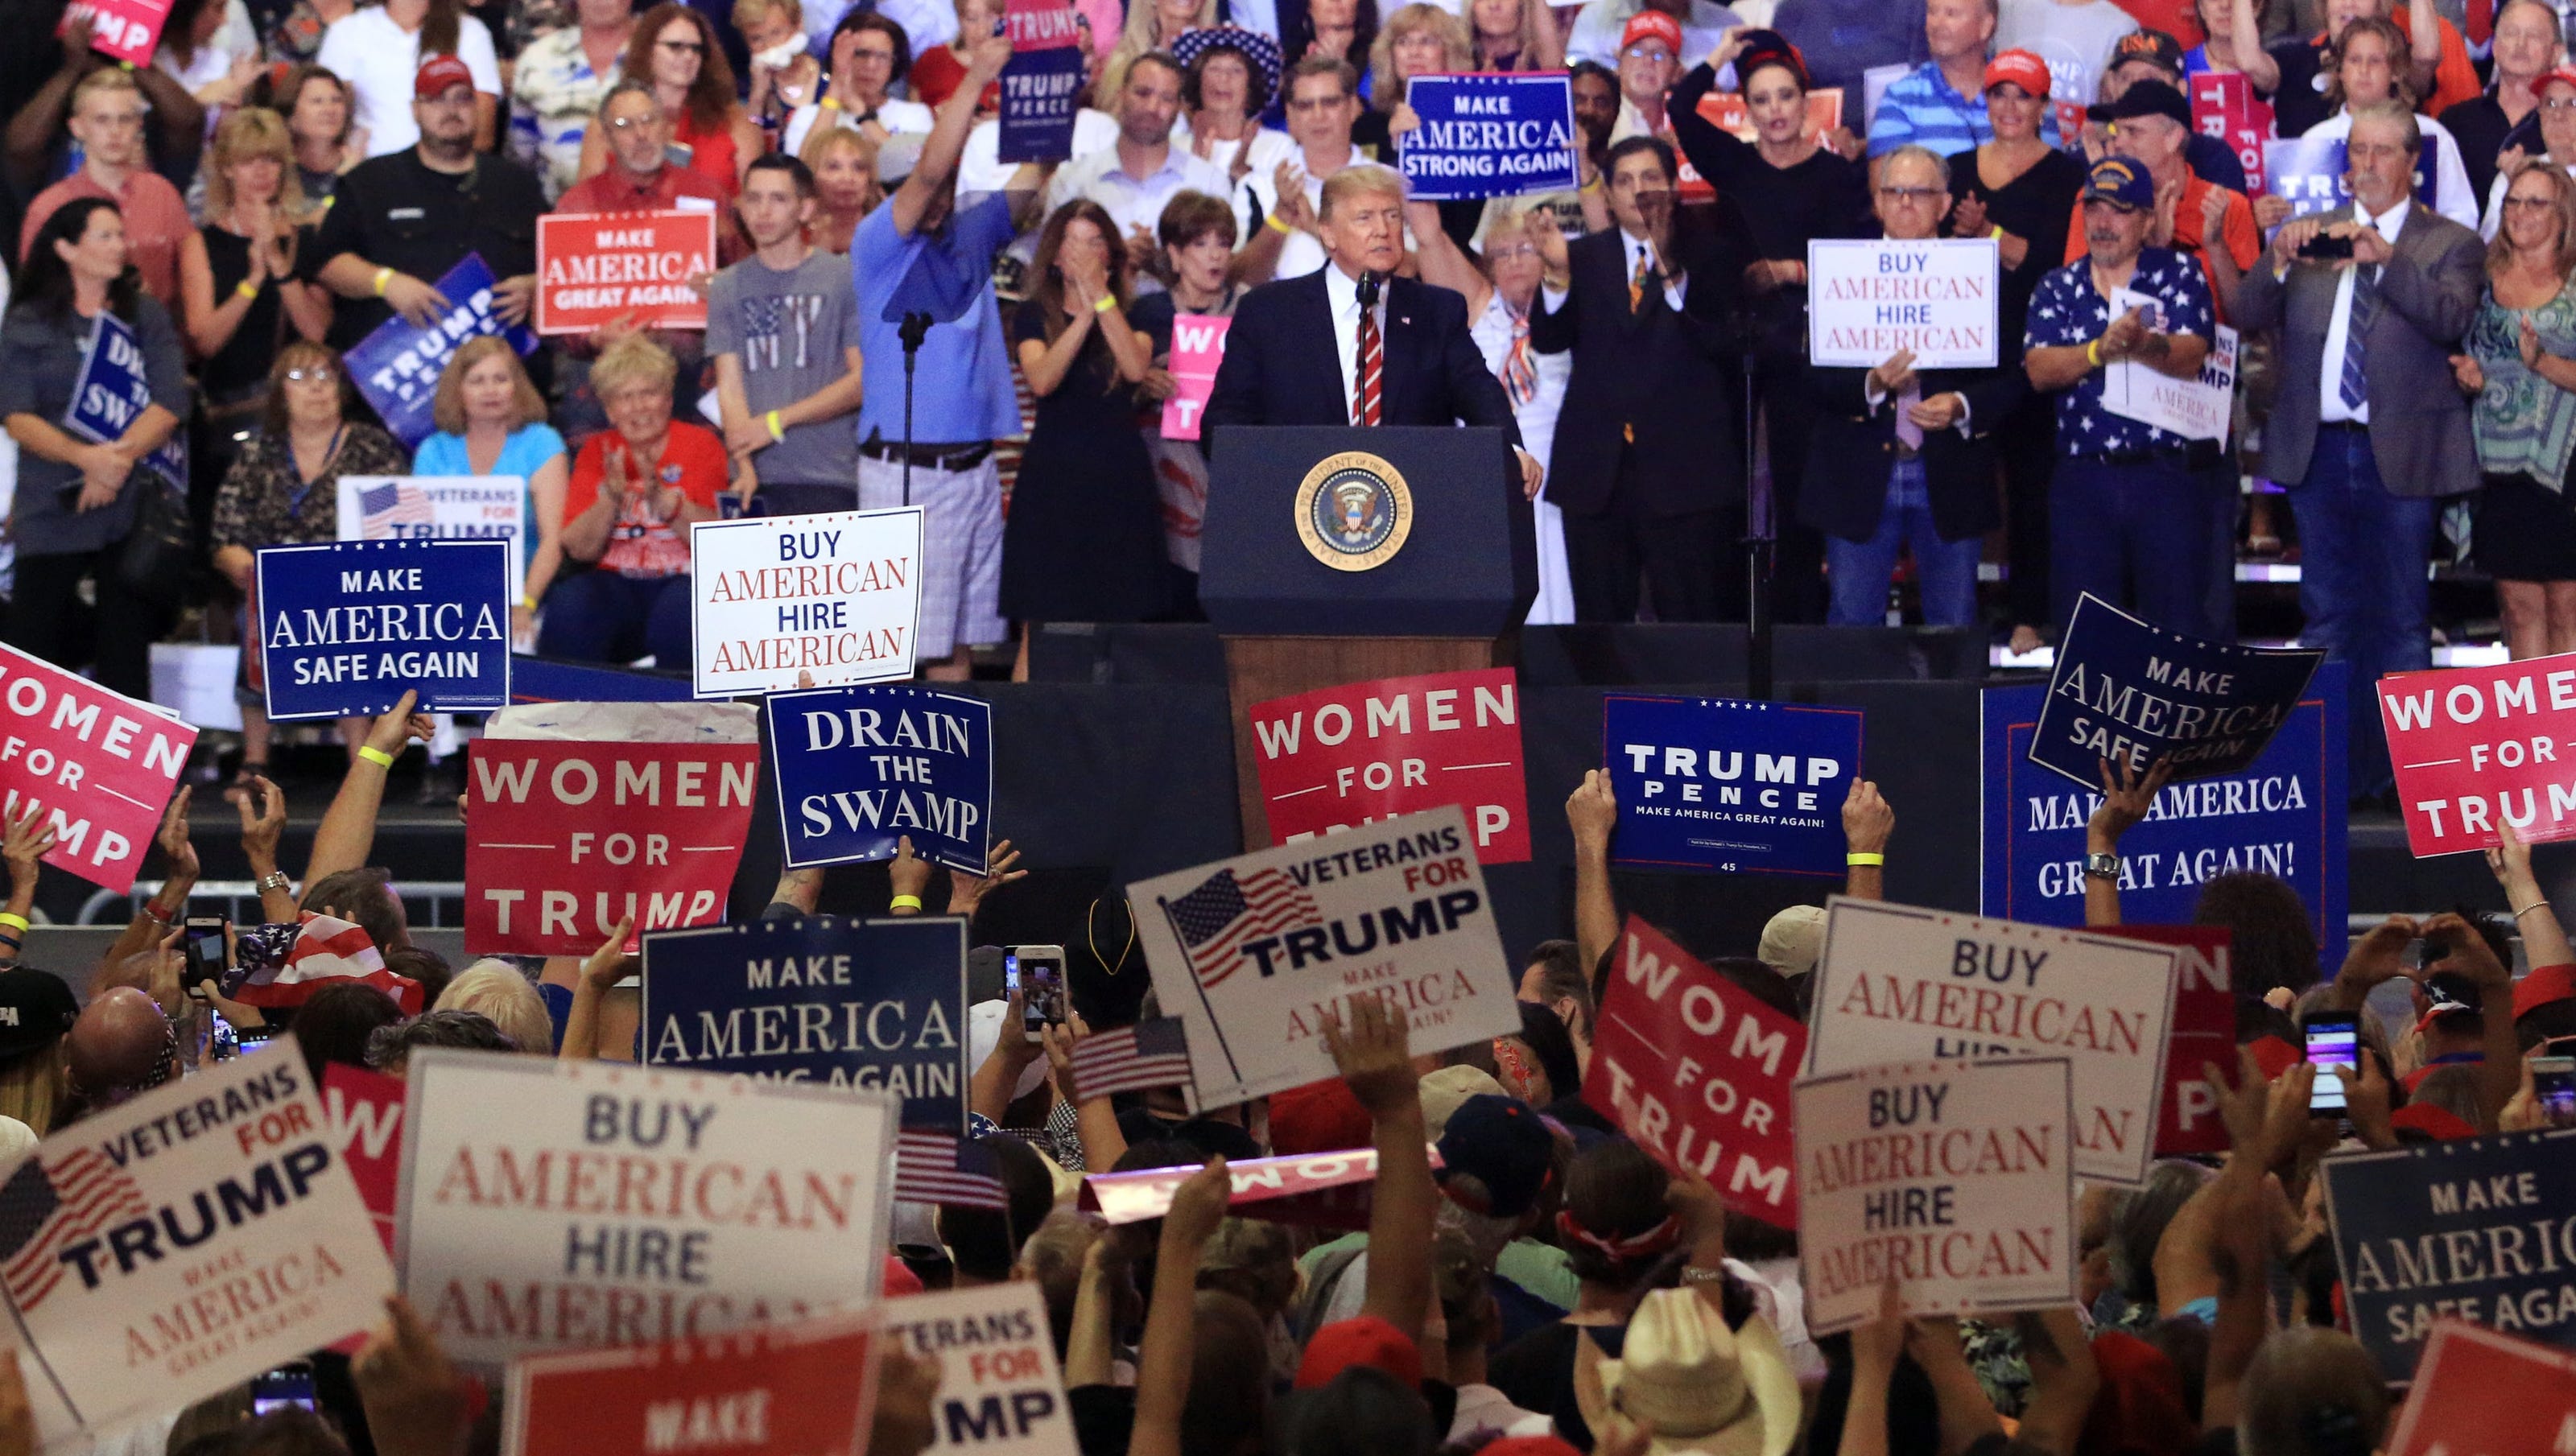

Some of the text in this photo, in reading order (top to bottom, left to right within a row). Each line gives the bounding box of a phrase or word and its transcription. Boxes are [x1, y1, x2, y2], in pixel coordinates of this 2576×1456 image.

[1006, 73, 1075, 98] TRUMP
[1010, 98, 1069, 116] PENCE
[1454, 95, 1510, 114] MAKE
[1405, 120, 1570, 151] AMERICA
[1405, 151, 1570, 176] STRONG AGAIN
[596, 229, 655, 249] MAKE
[547, 251, 707, 287] AMERICA
[1879, 253, 1928, 272] BUY
[554, 285, 699, 311] GREAT AGAIN
[1825, 276, 1984, 300] AMERICAN
[1876, 304, 1931, 324] HIRE
[370, 288, 493, 393] TRUMP
[1826, 326, 1984, 351] AMERICAN
[426, 489, 518, 501] VETERANS
[1299, 456, 1352, 506] PRESIDENT
[1385, 472, 1409, 521] UNITED
[483, 506, 516, 518] FOR
[779, 531, 840, 561] BUY
[341, 568, 423, 592] MAKE
[709, 558, 908, 603] AMERICAN
[267, 602, 503, 649] AMERICA
[778, 602, 846, 632] HIRE
[294, 650, 479, 685] SAFE AGAIN
[710, 627, 905, 673] AMERICAN
[2146, 656, 2233, 695] MAKE
[1256, 684, 1516, 759] WOMEN
[2056, 662, 2281, 739] AMERICA
[2385, 670, 2576, 732] WOME
[0, 667, 189, 781] OMEN
[802, 709, 970, 757] DRAIN
[2069, 718, 2151, 772] SAFE
[2, 738, 85, 792] FOR
[870, 755, 932, 785] THE
[1624, 744, 1839, 786] TRUMP
[2471, 736, 2557, 772] FOR
[474, 757, 754, 806] WOMEN
[1336, 758, 1428, 798] FOR
[1644, 780, 1817, 811] PENCE
[802, 790, 977, 843] SWAMP
[1636, 806, 1825, 828] MAKE AMERICA GREAT AGAIN!
[2028, 774, 2306, 832] MAK AMERICA
[2417, 782, 2576, 838] TRUM
[4, 788, 130, 867] UMP
[571, 833, 669, 864] FOR
[1289, 827, 1460, 886] VETERANS
[1404, 859, 1470, 893] FOR
[1721, 863, 1736, 871] 45
[2038, 842, 2294, 898] GRAT AGAIN!
[485, 889, 715, 937] TRUMP
[1242, 890, 1480, 978] TRUMP
[748, 955, 852, 988] MAKE
[1344, 962, 1398, 987] MAKE
[1952, 939, 2047, 987] BUY
[1625, 933, 1790, 1076] WOM
[1839, 971, 2146, 1055] AMERICAN
[651, 999, 957, 1063] AMERICA
[828, 1062, 956, 1098] AGAIN
[1674, 1056, 1775, 1135] FOR
[102, 1064, 298, 1168] VETERANS
[585, 1095, 716, 1149] BUY
[1869, 1084, 1948, 1128] BUY
[235, 1102, 312, 1157] FOR
[1605, 1058, 1790, 1206] TRUM
[1809, 1126, 2052, 1195] AMERICAN
[434, 1148, 857, 1230] AMERICAN
[1865, 1186, 1955, 1231] HIRE
[2429, 1172, 2540, 1215] MAKE
[59, 1143, 331, 1291] TRUMP
[564, 1226, 712, 1284] HIRE
[1818, 1227, 2054, 1298] AMERICAN
[2355, 1215, 2576, 1293] AMERIC
[124, 1244, 343, 1369] AMERICA
[2495, 1285, 2576, 1330] AGA
[890, 1309, 1034, 1354] ERANS
[970, 1347, 1043, 1384] FOR
[647, 1388, 770, 1450] MAKE
[945, 1390, 1055, 1443] MP
